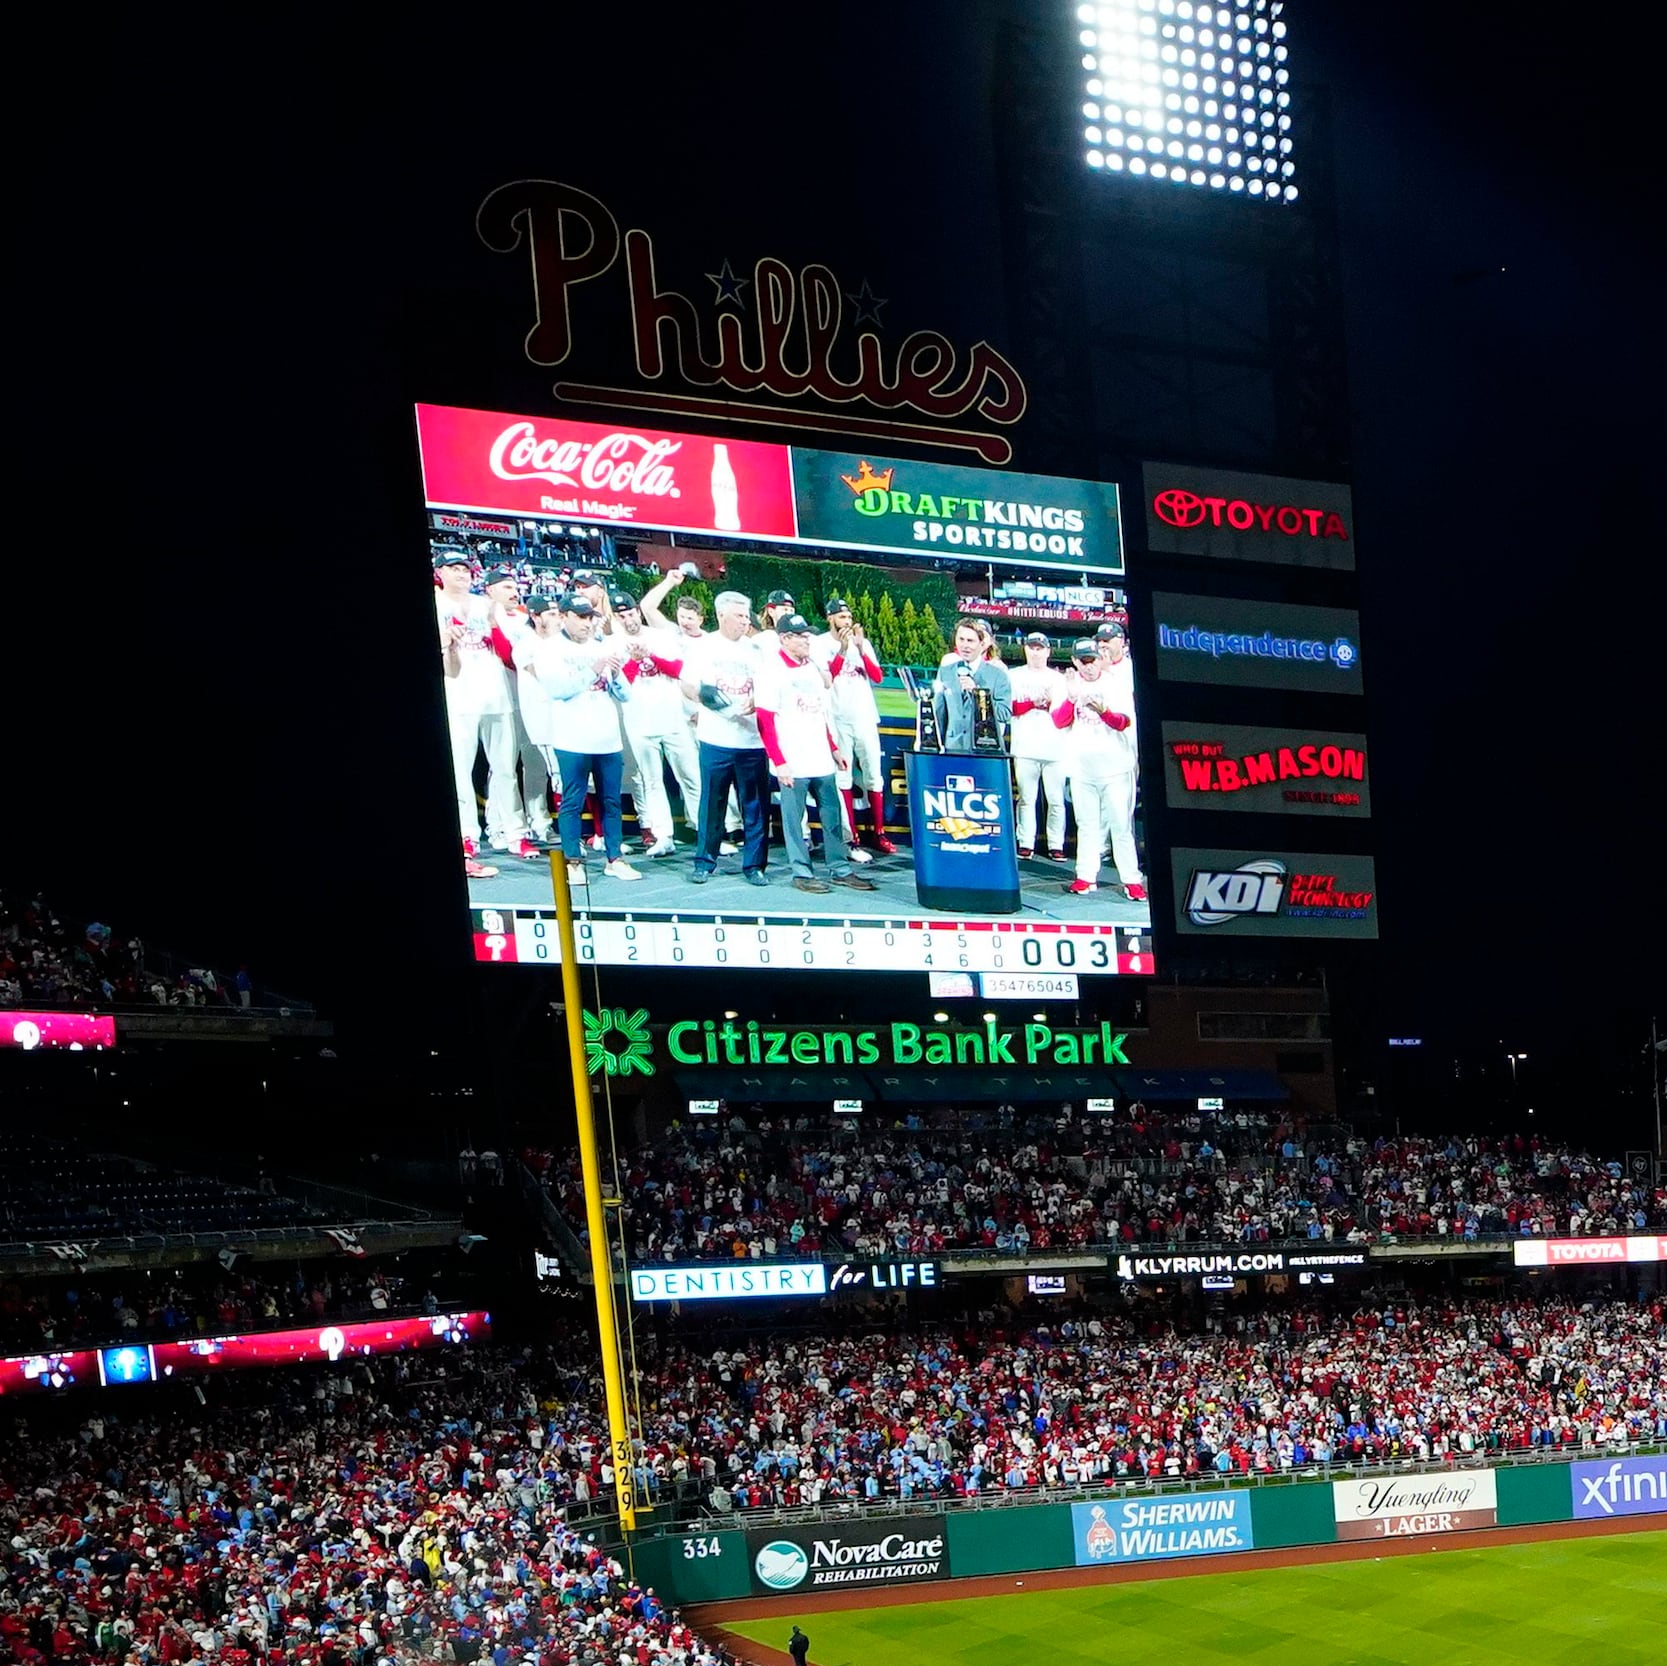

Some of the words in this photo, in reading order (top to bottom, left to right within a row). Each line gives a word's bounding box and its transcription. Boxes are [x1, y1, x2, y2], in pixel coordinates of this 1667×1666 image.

[476, 179, 1027, 424] Phillies
[489, 422, 682, 499] Coca-Cola
[541, 495, 592, 515] Real
[594, 500, 631, 521] Magic
[855, 487, 1084, 533] DRAFTKINGS
[1203, 498, 1348, 541] TOYOTA
[913, 521, 1084, 557] SPORTSBOOK
[1159, 622, 1326, 662] Independence
[1172, 743, 1199, 756] WHO
[1202, 743, 1223, 757] BUT
[923, 790, 1002, 820] NLCS
[1188, 871, 1286, 913] KDI
[625, 925, 636, 940] 0
[715, 928, 725, 943] 0
[758, 929, 767, 944] 0
[802, 930, 811, 944] 2
[628, 946, 638, 960] 2
[672, 947, 683, 962] 0
[717, 948, 727, 962] 0
[760, 949, 770, 963] 0
[1023, 938, 1042, 967] 0
[1056, 939, 1075, 967] 0
[1090, 940, 1109, 968] 3
[989, 979, 1073, 993] 354765045
[668, 1019, 880, 1067] Citizens
[892, 1020, 1014, 1066] Bank
[1025, 1020, 1131, 1067] Park
[743, 1077, 940, 1088] HARRY
[994, 1077, 1091, 1088] THE
[1134, 1254, 1283, 1276] KLYRRUM.COM
[1552, 1242, 1624, 1260] TOYOTA
[637, 1269, 816, 1296] DENTISTRY
[830, 1265, 866, 1291] for
[872, 1263, 934, 1288] LIFE
[1357, 1477, 1477, 1511] Yuengling
[1121, 1500, 1235, 1528] SHERWIN
[1382, 1513, 1454, 1537] LAGER
[683, 1536, 720, 1559] 334
[811, 1535, 940, 1568] NovaCare
[813, 1559, 940, 1586] REHABILITATION
